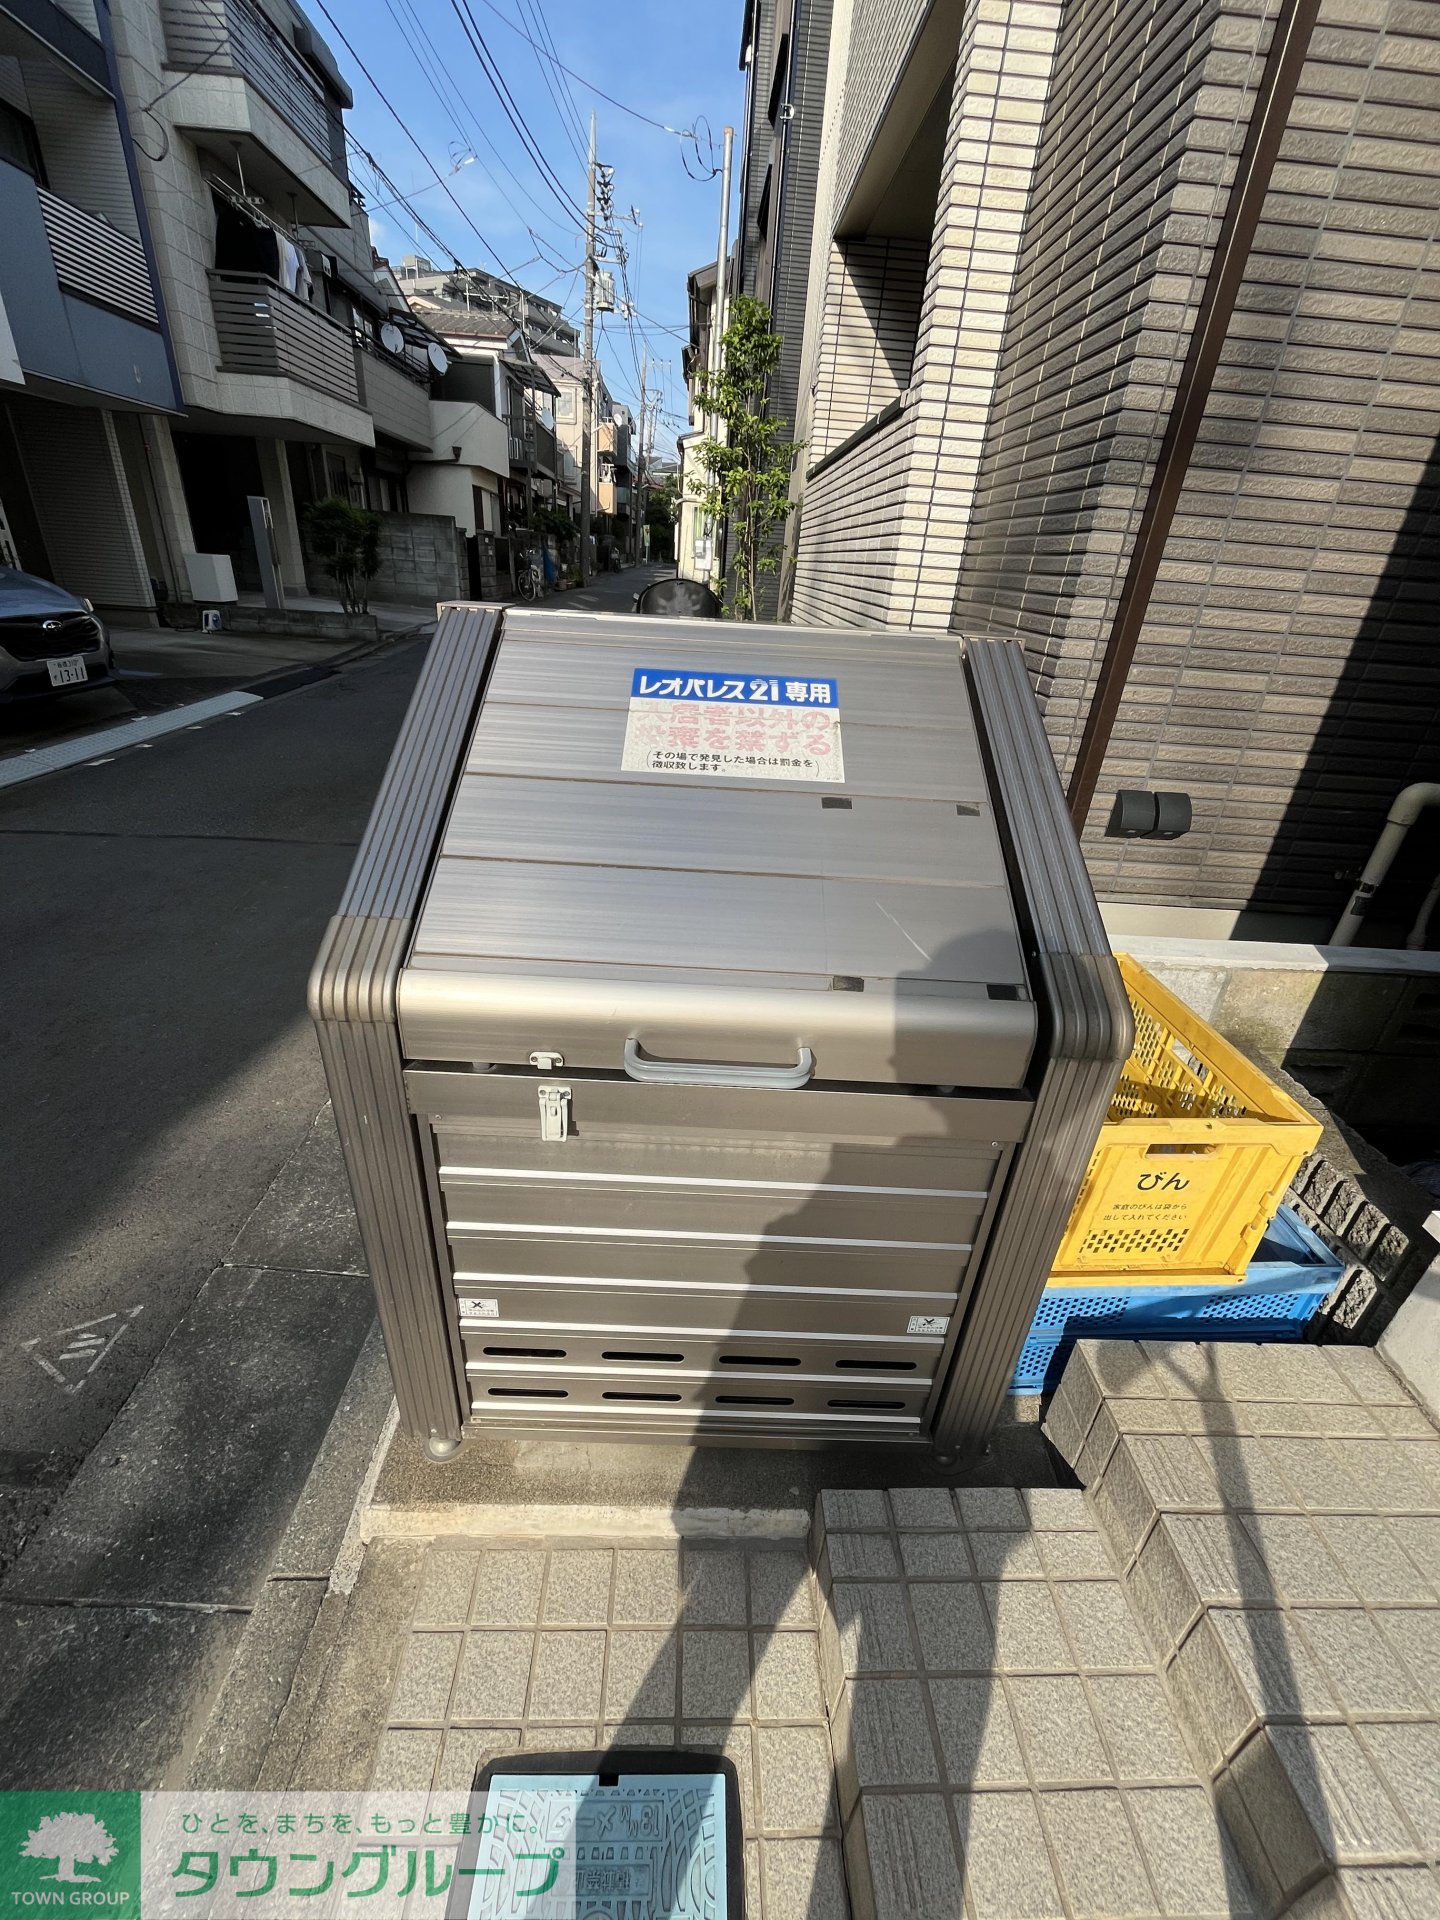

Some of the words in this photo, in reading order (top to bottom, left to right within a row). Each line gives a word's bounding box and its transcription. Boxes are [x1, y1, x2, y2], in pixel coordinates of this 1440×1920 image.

[1137, 1171, 1190, 1191] びん
[1112, 1203, 1188, 1211] 家庭のびんは袋から
